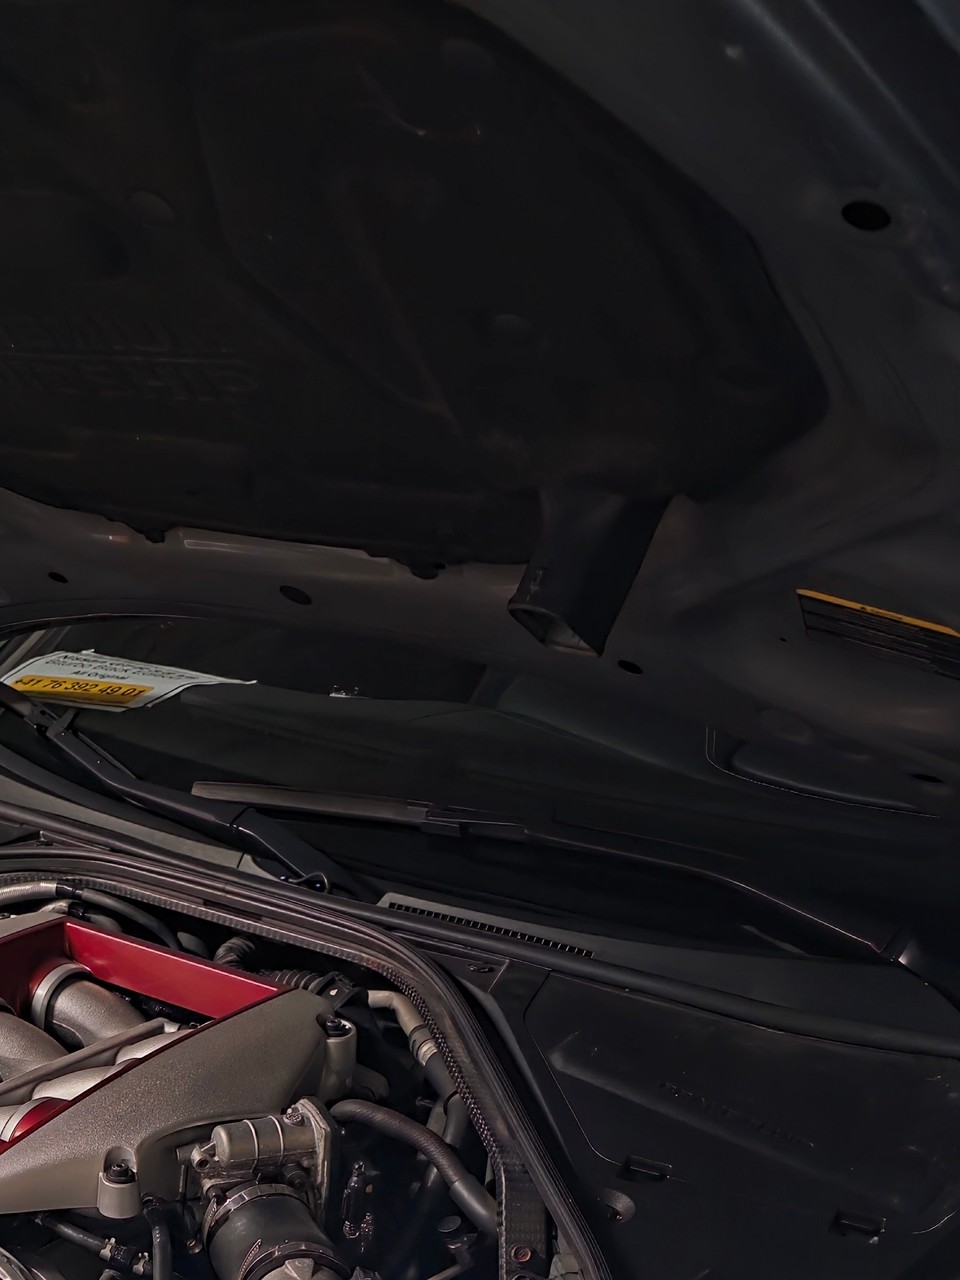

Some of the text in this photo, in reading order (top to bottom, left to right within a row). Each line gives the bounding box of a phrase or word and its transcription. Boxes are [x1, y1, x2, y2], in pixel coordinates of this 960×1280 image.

[43, 679, 66, 689] 76
[65, 681, 99, 692] 392
[99, 685, 122, 695] 49
[121, 687, 146, 697] 01
